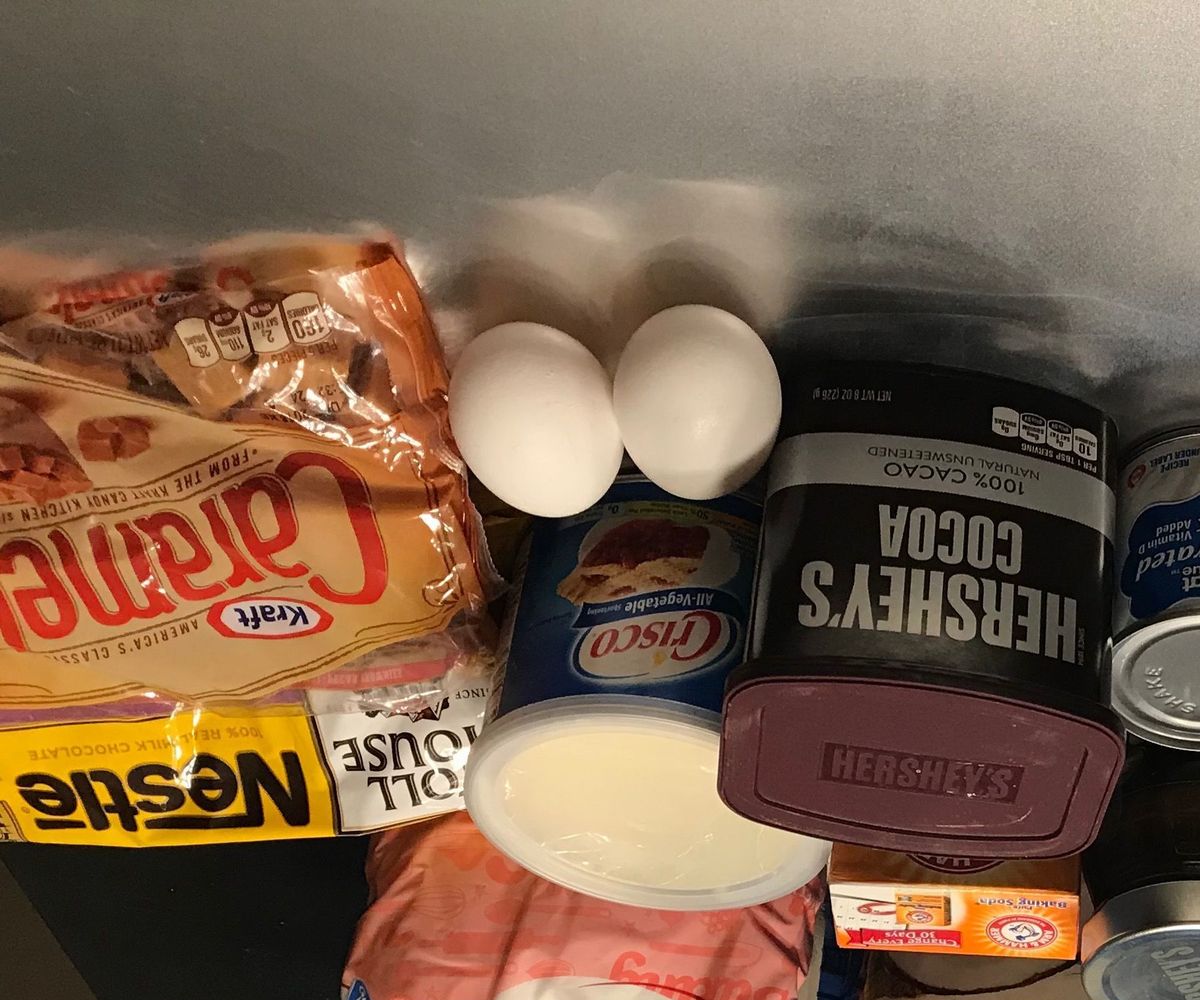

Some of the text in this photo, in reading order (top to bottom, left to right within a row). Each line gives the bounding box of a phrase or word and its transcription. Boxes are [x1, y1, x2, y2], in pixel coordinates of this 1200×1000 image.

[251, 316, 278, 330] SAT FAT
[860, 390, 875, 401] WT
[876, 390, 892, 402] NET
[1021, 443, 1053, 457] SERVING
[1150, 453, 1173, 468] LABEL
[208, 448, 249, 477] FROM
[868, 446, 1040, 481] NATURAL UNSWEETENED
[1083, 461, 1097, 473] PER
[1160, 459, 1189, 473] RECIPE
[174, 470, 202, 492] THE
[883, 462, 1025, 496] 100% CACAO
[84, 489, 127, 507] CANDY
[20, 497, 82, 522] KITCHEN
[1155, 519, 1192, 536] Added
[878, 503, 1023, 576] COCOA
[1137, 530, 1193, 555] Vitamin D
[624, 591, 715, 614] All-Vegetable
[797, 560, 1077, 664] HERSHEY'S
[233, 604, 309, 630] Kraft
[117, 619, 199, 655] AMERICA'S
[590, 611, 721, 661] Crisco
[1144, 667, 1197, 714] SHAKE
[27, 741, 128, 761] CHOCOLATE
[831, 747, 1014, 799] HERSHEY'S
[367, 768, 464, 811] OLL
[979, 897, 1069, 909] Baking Soda
[865, 936, 958, 947] Change Every
[884, 930, 936, 939] 30 Days
[989, 927, 1027, 949] HAMMER
[1038, 929, 1054, 946] ARM
